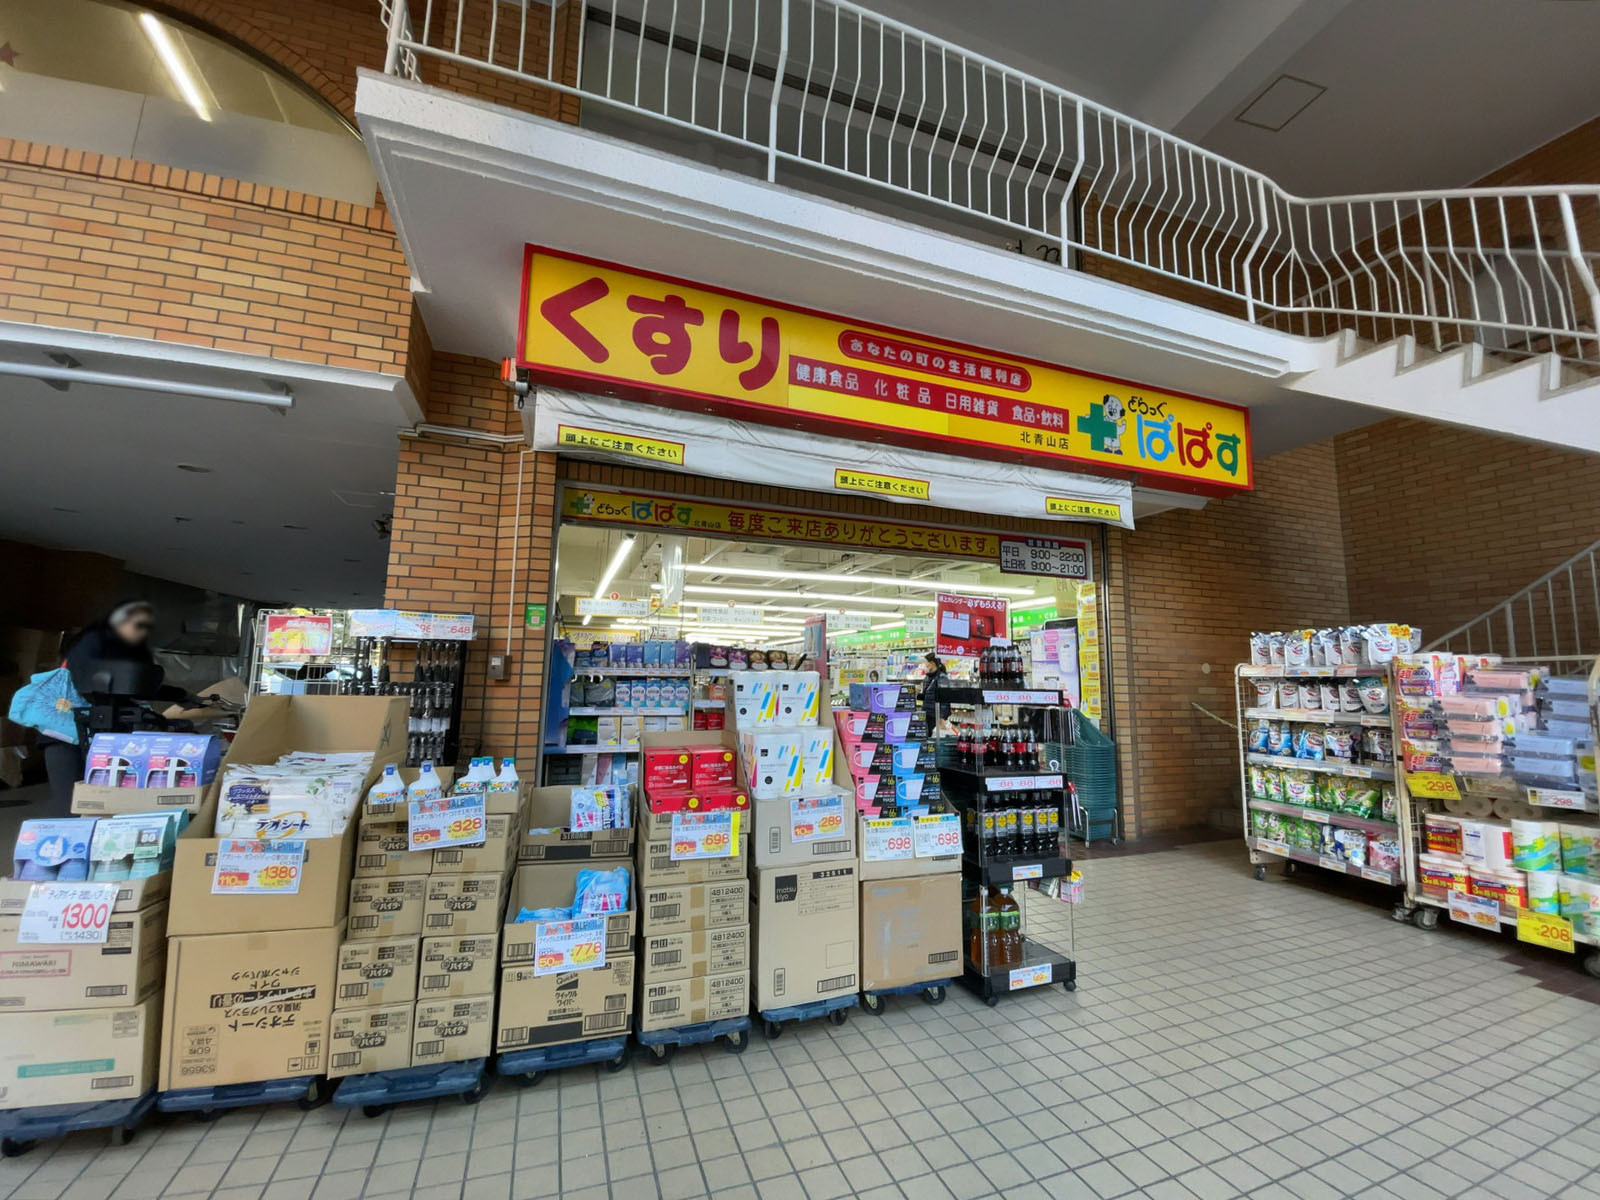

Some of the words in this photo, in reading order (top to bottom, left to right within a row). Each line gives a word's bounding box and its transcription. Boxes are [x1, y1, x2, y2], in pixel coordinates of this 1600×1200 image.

[540, 277, 780, 391] くすり
[849, 337, 1022, 388] あなたの町の生活便利店
[795, 363, 860, 391] 健康食品
[875, 379, 931, 405] 化粧品
[945, 394, 999, 418] 日用雑貨
[565, 431, 678, 459] 頭上にご注意ください
[1020, 431, 1069, 450] 北青山店
[1137, 414, 1241, 477] ぱぱす
[839, 474, 925, 496] 頭上にご注意ください
[631, 500, 693, 525] ぱぱす
[1049, 502, 1118, 518] 頭上にご注意ください
[728, 511, 996, 554] 毎度ご来店ありがとうございます。
[1002, 546, 1020, 557] 平日
[1002, 558, 1026, 570] 土日祝
[450, 625, 471, 634] 648
[1427, 781, 1455, 792] 298
[1553, 797, 1573, 806] 298
[256, 819, 310, 832] デオシート
[451, 818, 482, 833] 328
[821, 815, 842, 827] 289
[414, 833, 431, 843] 50
[706, 833, 729, 845] 698
[888, 837, 911, 850] 698
[938, 832, 959, 845] 698
[264, 866, 297, 879] 1380
[220, 875, 238, 885] 110
[712, 886, 744, 896] 4812400
[776, 886, 797, 894] matsu
[62, 903, 109, 929] 1300
[712, 931, 744, 942] 4812400
[1539, 925, 1571, 942] 208
[575, 942, 602, 957] 778
[538, 957, 555, 968] 50
[231, 967, 300, 981] ジャンボパック
[249, 979, 280, 990] ワイド
[711, 977, 743, 988] 4812400
[555, 991, 577, 999] クイックル
[224, 1002, 302, 1018] 消臭&フレグランス
[228, 1014, 296, 1032] デオシート
